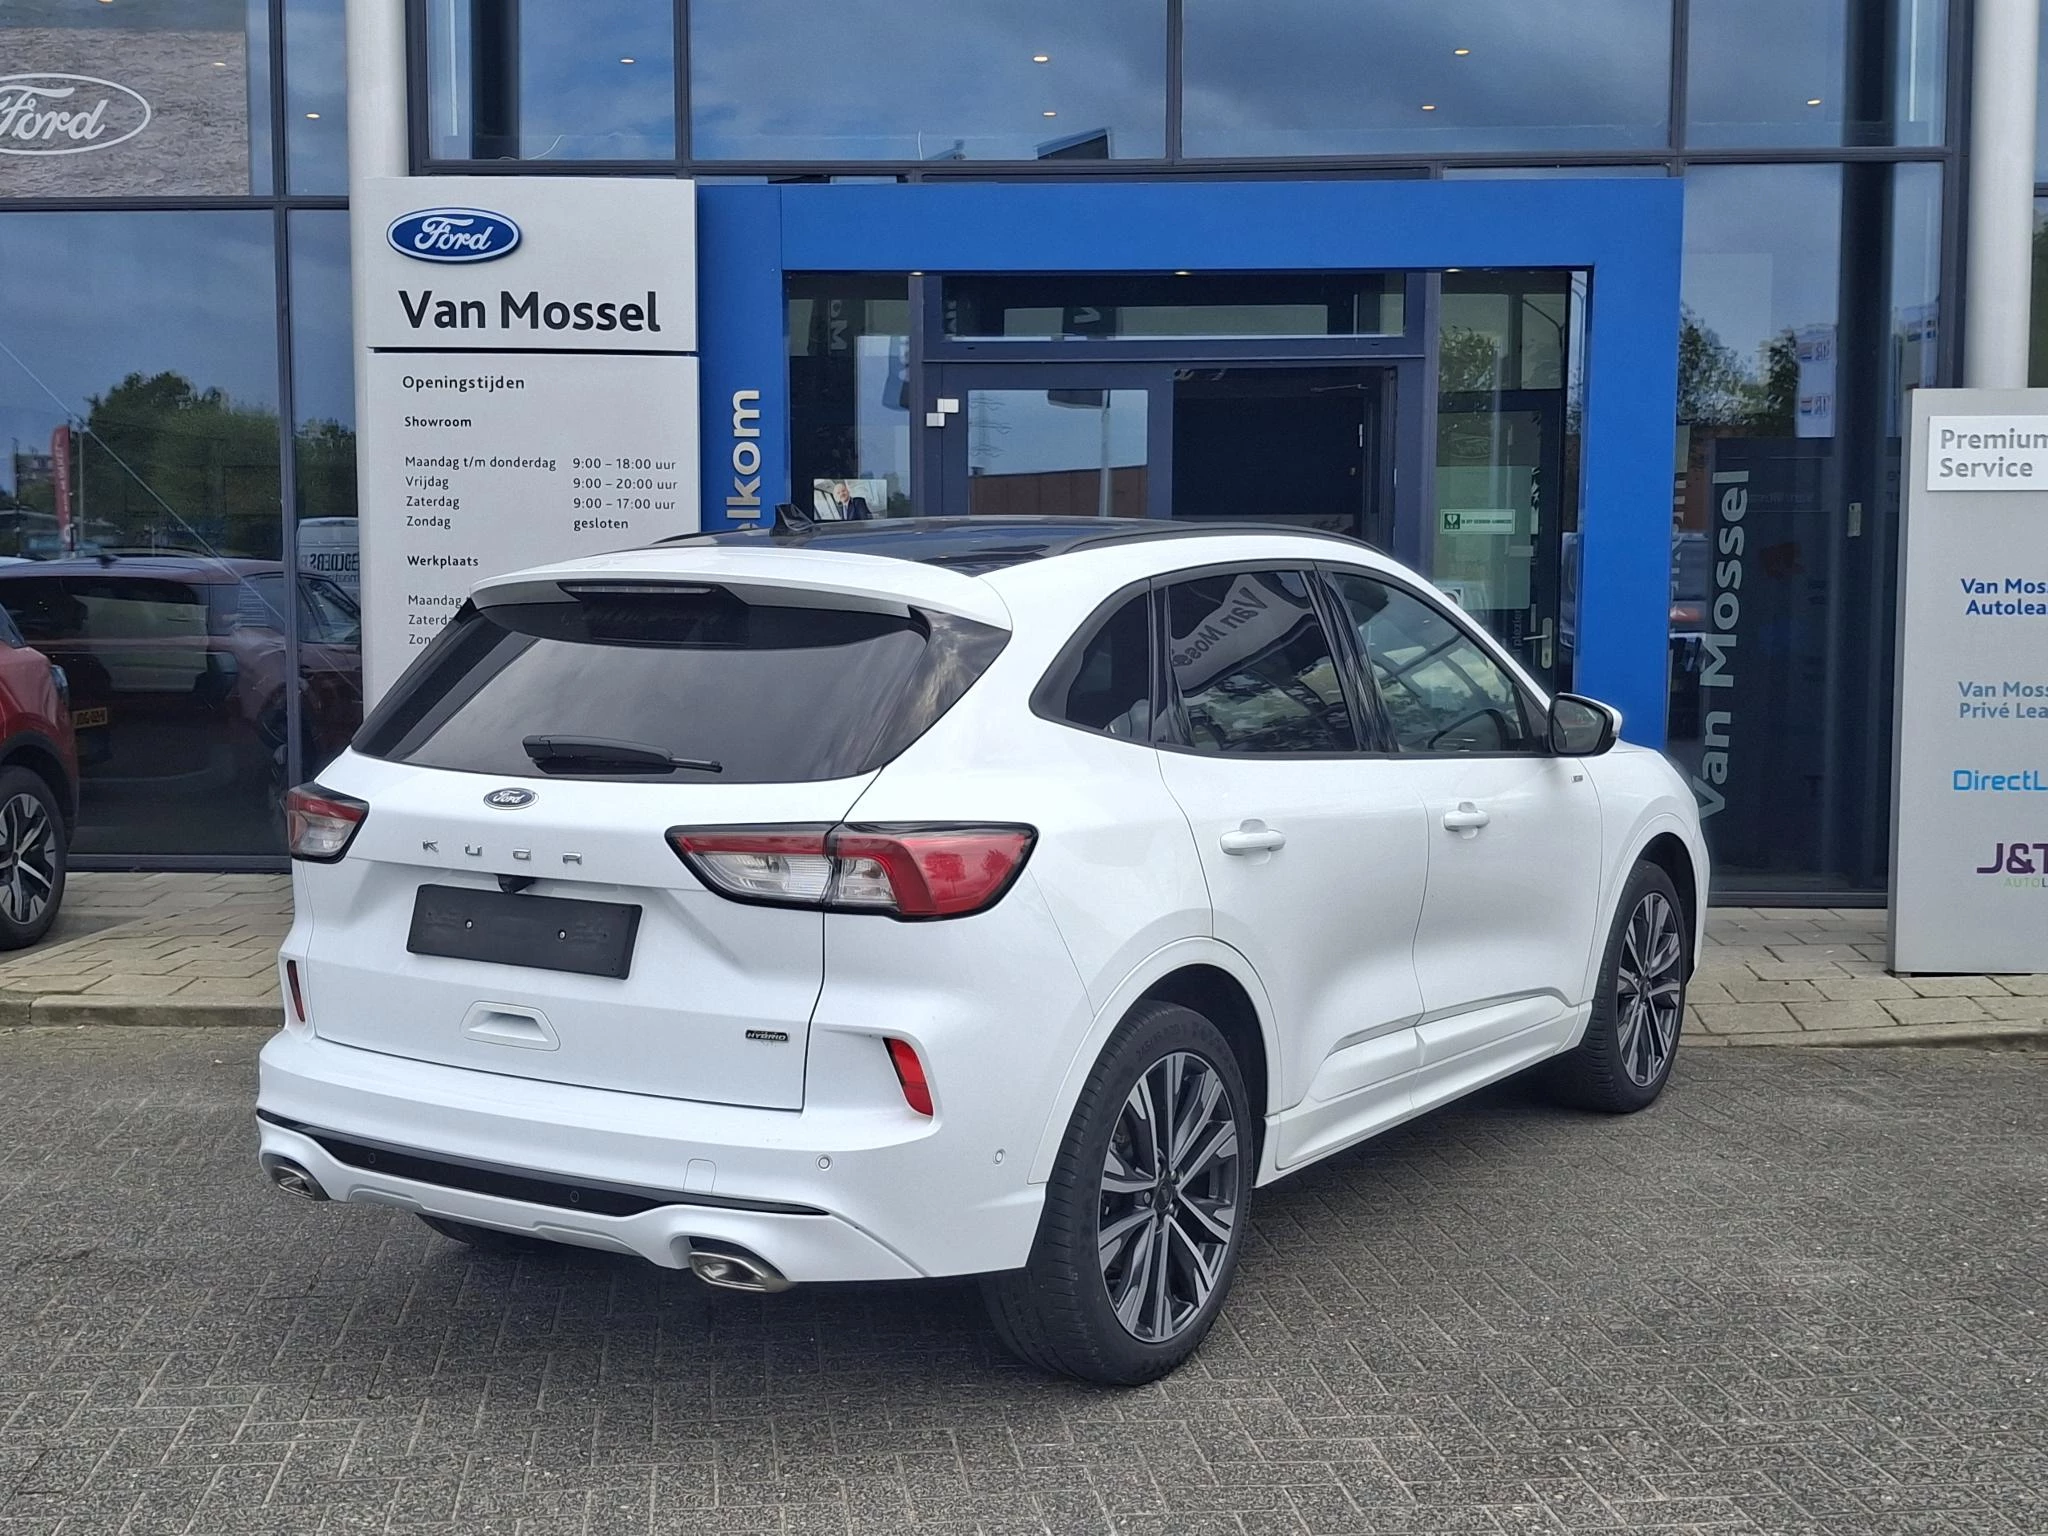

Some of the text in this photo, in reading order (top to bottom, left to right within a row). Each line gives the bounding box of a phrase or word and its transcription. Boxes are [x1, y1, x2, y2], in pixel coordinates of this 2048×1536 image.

[414, 216, 494, 251] Ford
[398, 290, 661, 333] Van Mossel
[402, 374, 525, 393] Openingstijden
[404, 415, 472, 428] Showroom
[1941, 428, 2048, 449] Premium
[405, 456, 460, 470] Maandag
[463, 456, 486, 469] t/m
[489, 456, 557, 472] donderdag
[573, 457, 602, 470] 9:00
[616, 457, 652, 470] 18:00
[655, 461, 677, 471] uur
[1940, 456, 2033, 478] Service
[405, 475, 450, 491] Vrijdag
[573, 477, 602, 490] 9:00
[616, 477, 653, 490] 20:00
[656, 481, 679, 491] uur
[406, 495, 460, 510] Zaterdag
[573, 497, 602, 510] 9:00
[616, 497, 651, 510] 17:00
[654, 501, 676, 511] uur
[406, 515, 629, 531] Zondag gesloten
[407, 555, 479, 569] Werkplaats
[1961, 578, 2048, 594] Van Mos
[408, 595, 462, 609] Maandag
[408, 614, 454, 625] Zaterd
[1692, 470, 1749, 819] Van Mossel
[1958, 682, 1997, 697] Van
[1959, 702, 2048, 718] Privé Lea
[1953, 770, 2048, 791] DirectL
[422, 839, 583, 865] KUGA
[746, 1031, 787, 1041] HYBRID
